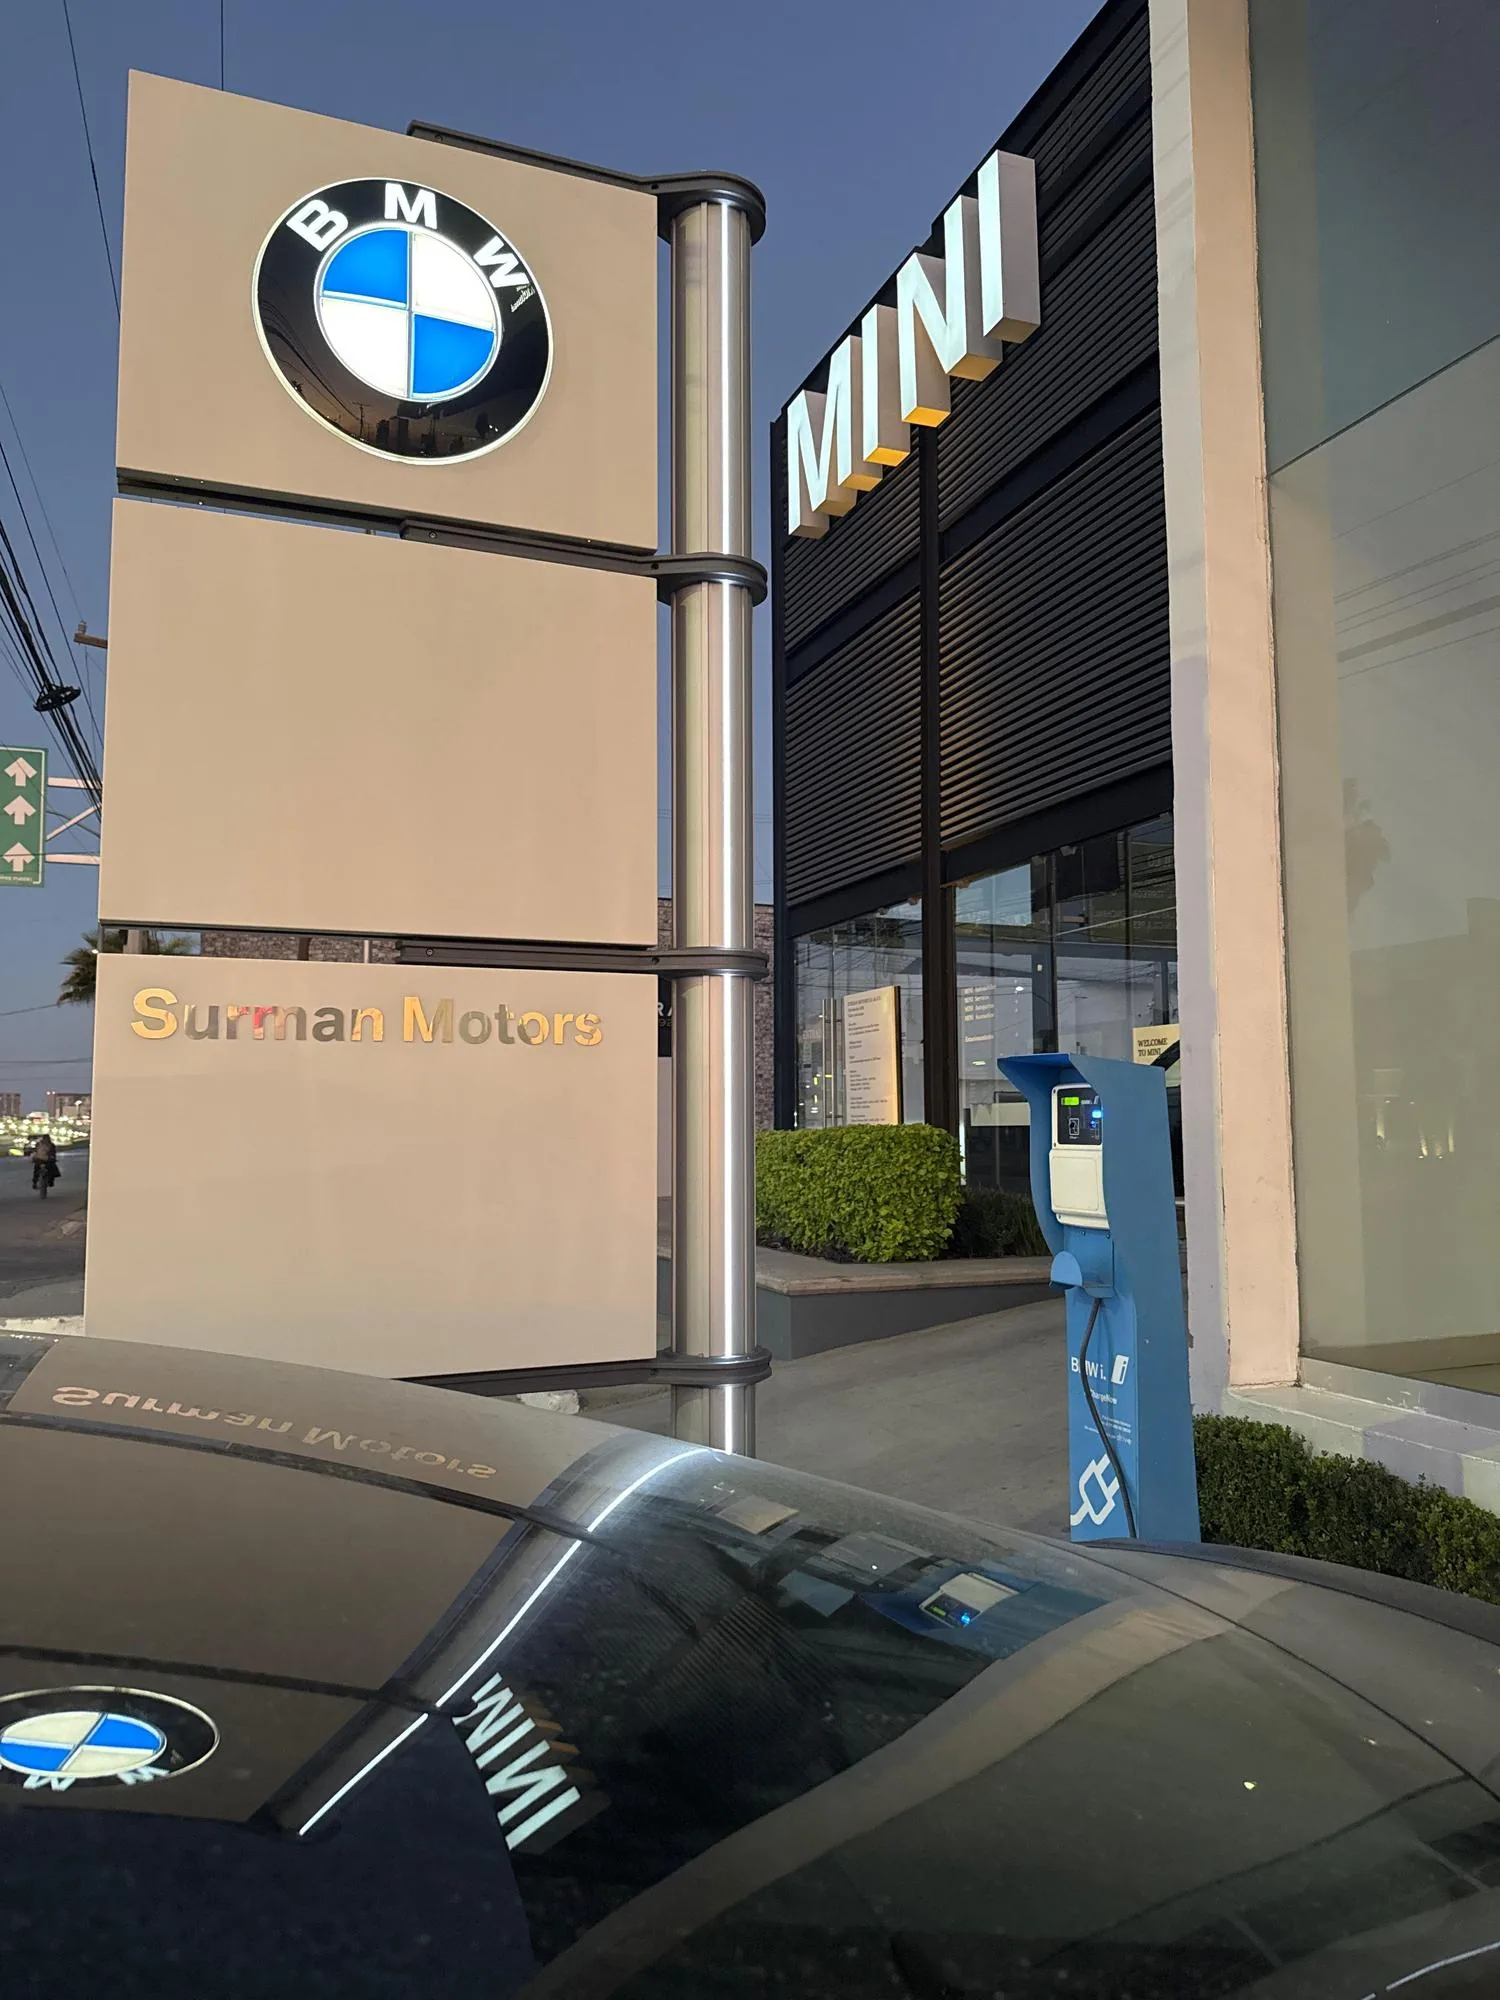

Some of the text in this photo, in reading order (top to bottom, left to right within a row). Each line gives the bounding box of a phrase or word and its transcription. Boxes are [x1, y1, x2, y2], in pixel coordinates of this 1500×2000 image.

[286, 182, 530, 288] BMW
[787, 149, 1038, 539] MINI
[130, 987, 603, 1046] Surman Motors
[1137, 1038, 1168, 1047] WELCOME
[1147, 1048, 1161, 1056] MINI
